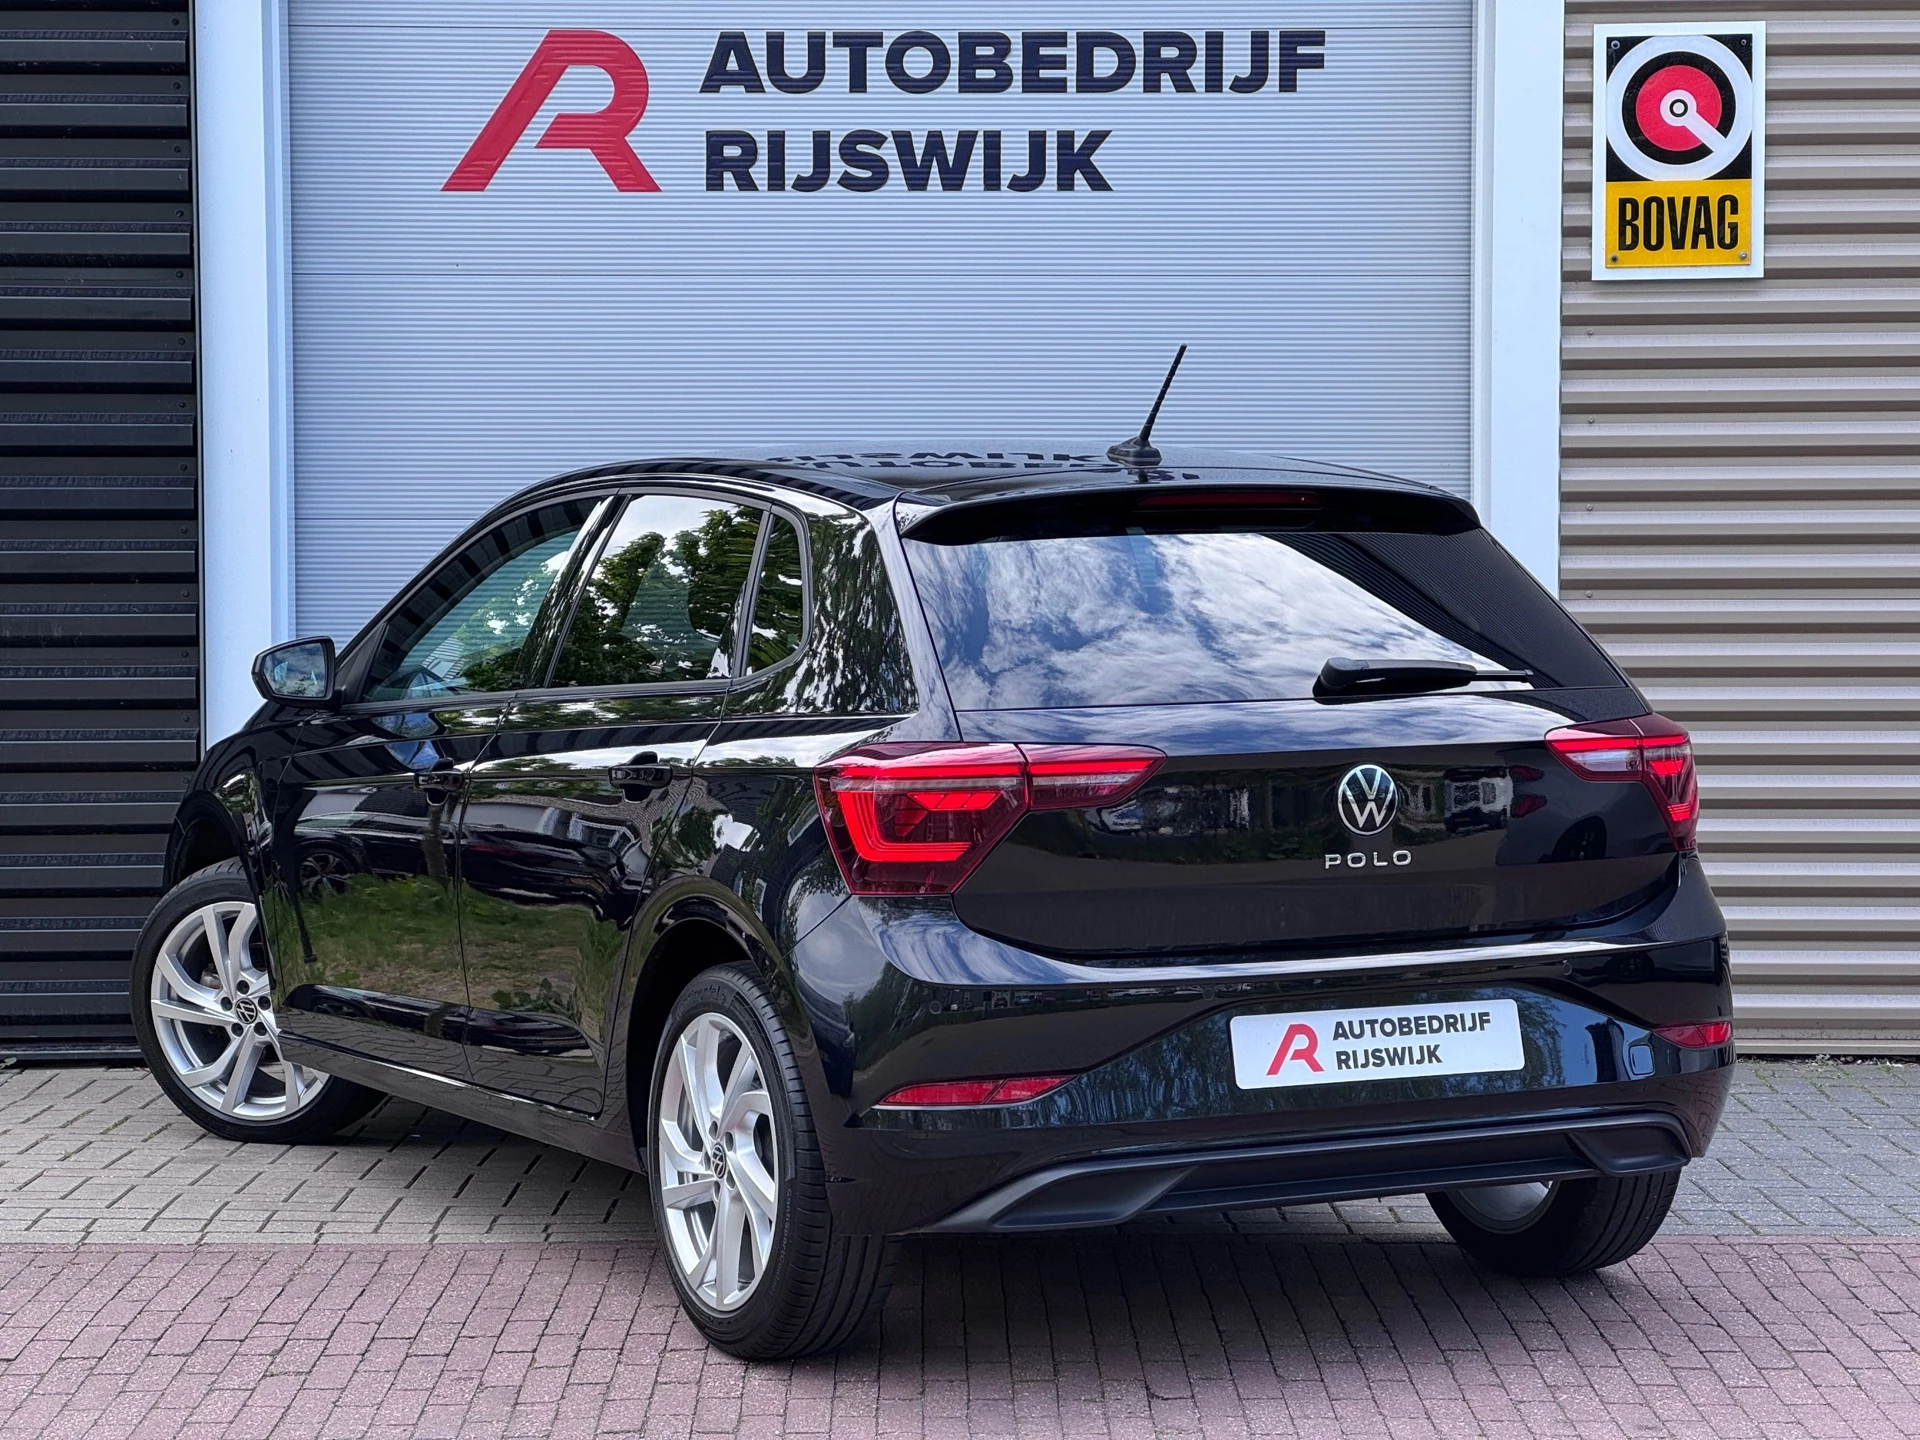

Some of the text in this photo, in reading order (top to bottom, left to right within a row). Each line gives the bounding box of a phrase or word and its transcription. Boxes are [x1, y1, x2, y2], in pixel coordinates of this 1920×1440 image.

[700, 30, 1326, 95] AUTOBEDRIJF
[705, 130, 1114, 193] RIJSWIJK
[1618, 194, 1739, 252] BOVAG
[1324, 850, 1412, 870] POLO
[1332, 1011, 1491, 1041] AUTOBEDRIJF
[1335, 1044, 1443, 1070] RIJSWIJK
